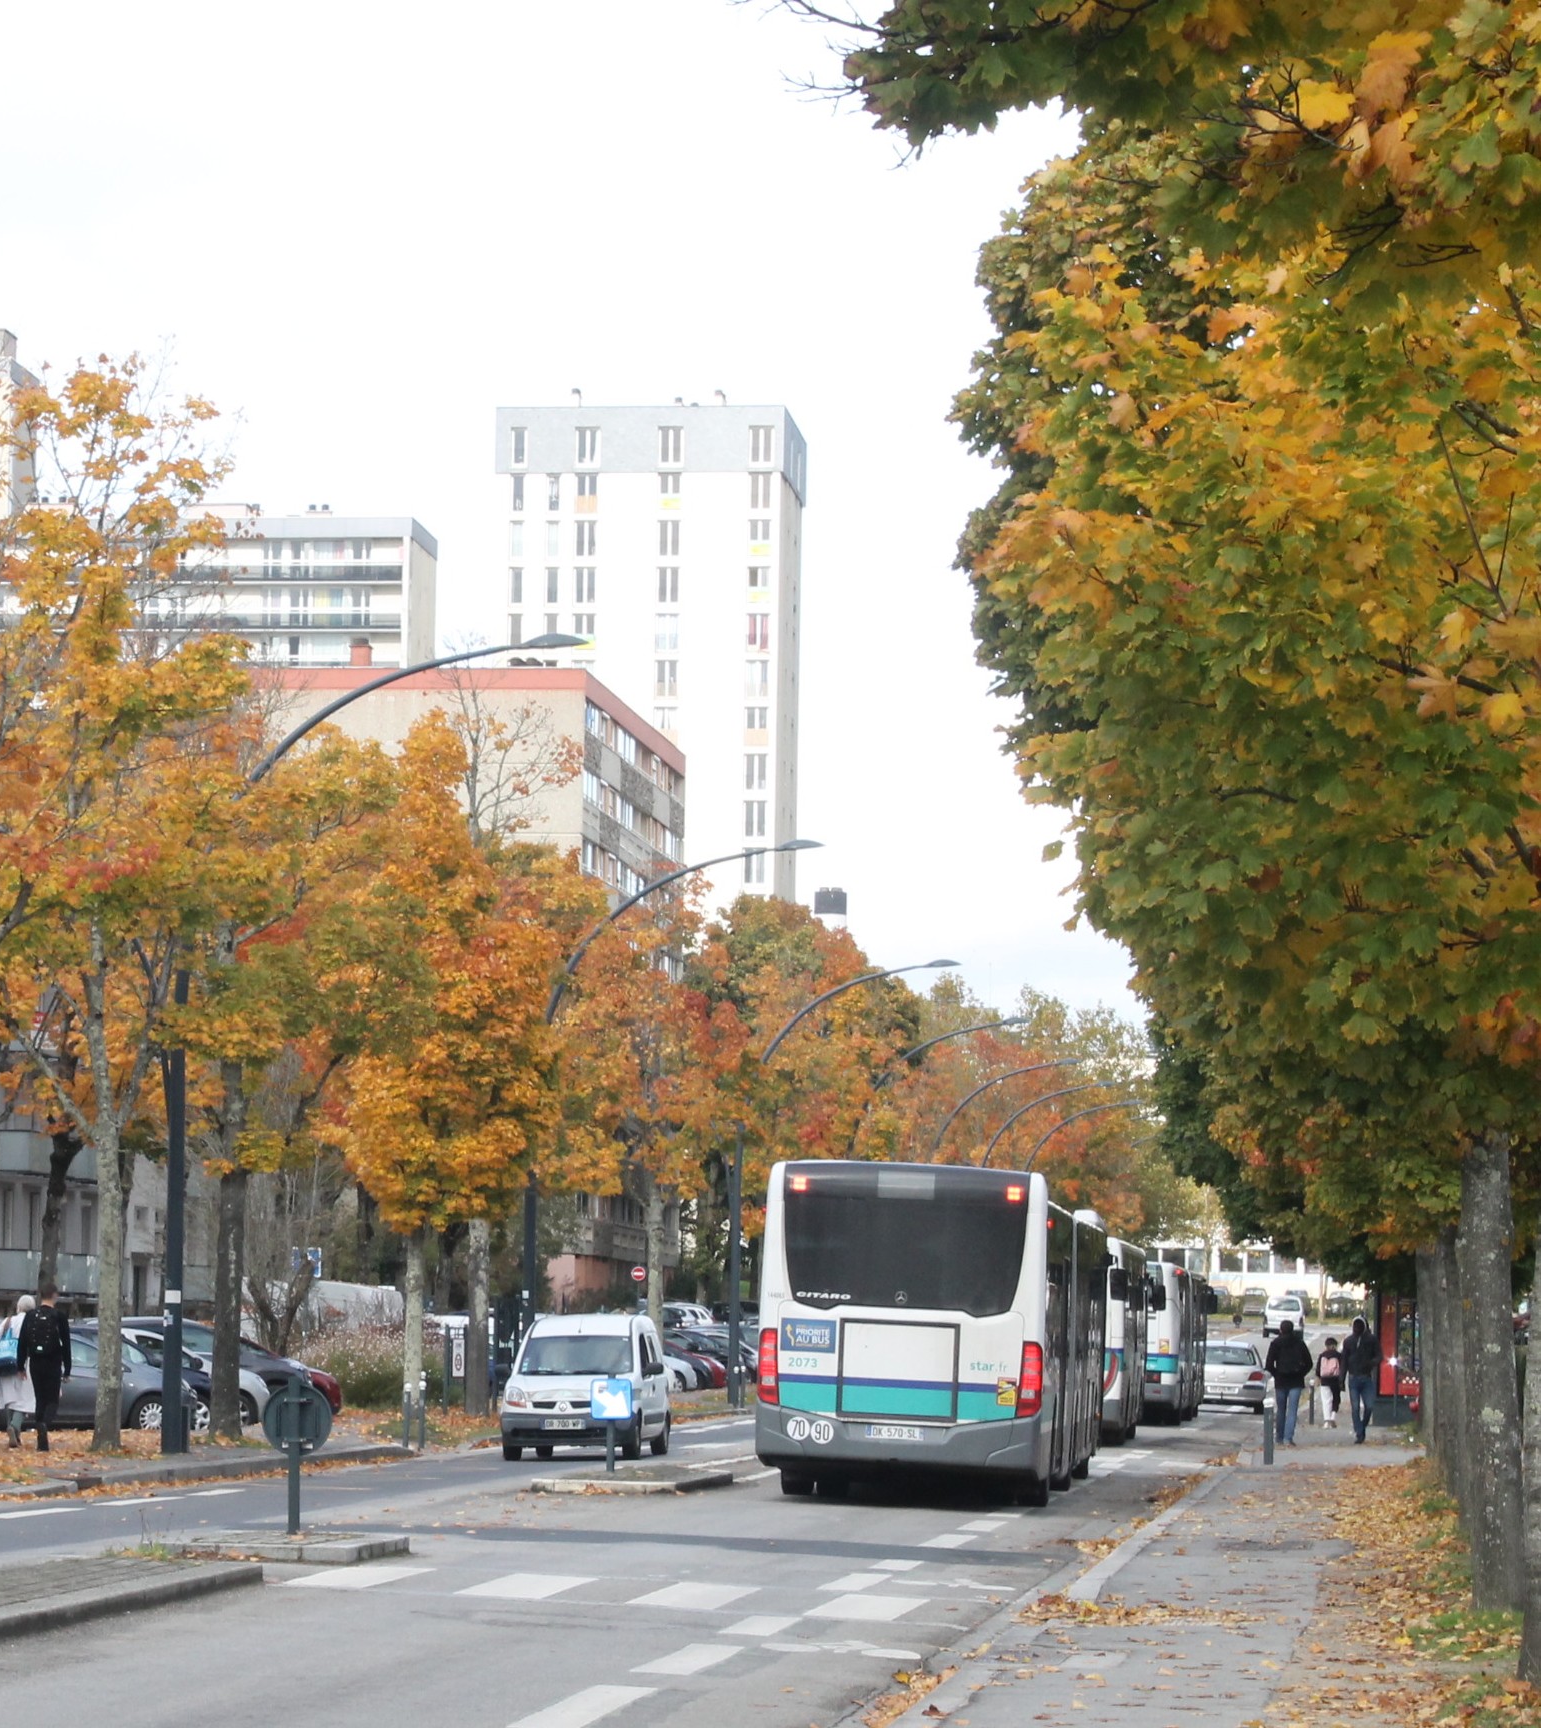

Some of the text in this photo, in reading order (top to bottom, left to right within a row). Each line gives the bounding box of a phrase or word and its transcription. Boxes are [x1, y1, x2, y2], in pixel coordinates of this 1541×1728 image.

[796, 1291, 851, 1300] CITARO
[796, 1335, 809, 1344] AU
[812, 1336, 830, 1345] BUS
[788, 1357, 818, 1368] 2073
[970, 1361, 1007, 1372] star.fr
[792, 1420, 806, 1437] 70
[814, 1423, 829, 1441] 90
